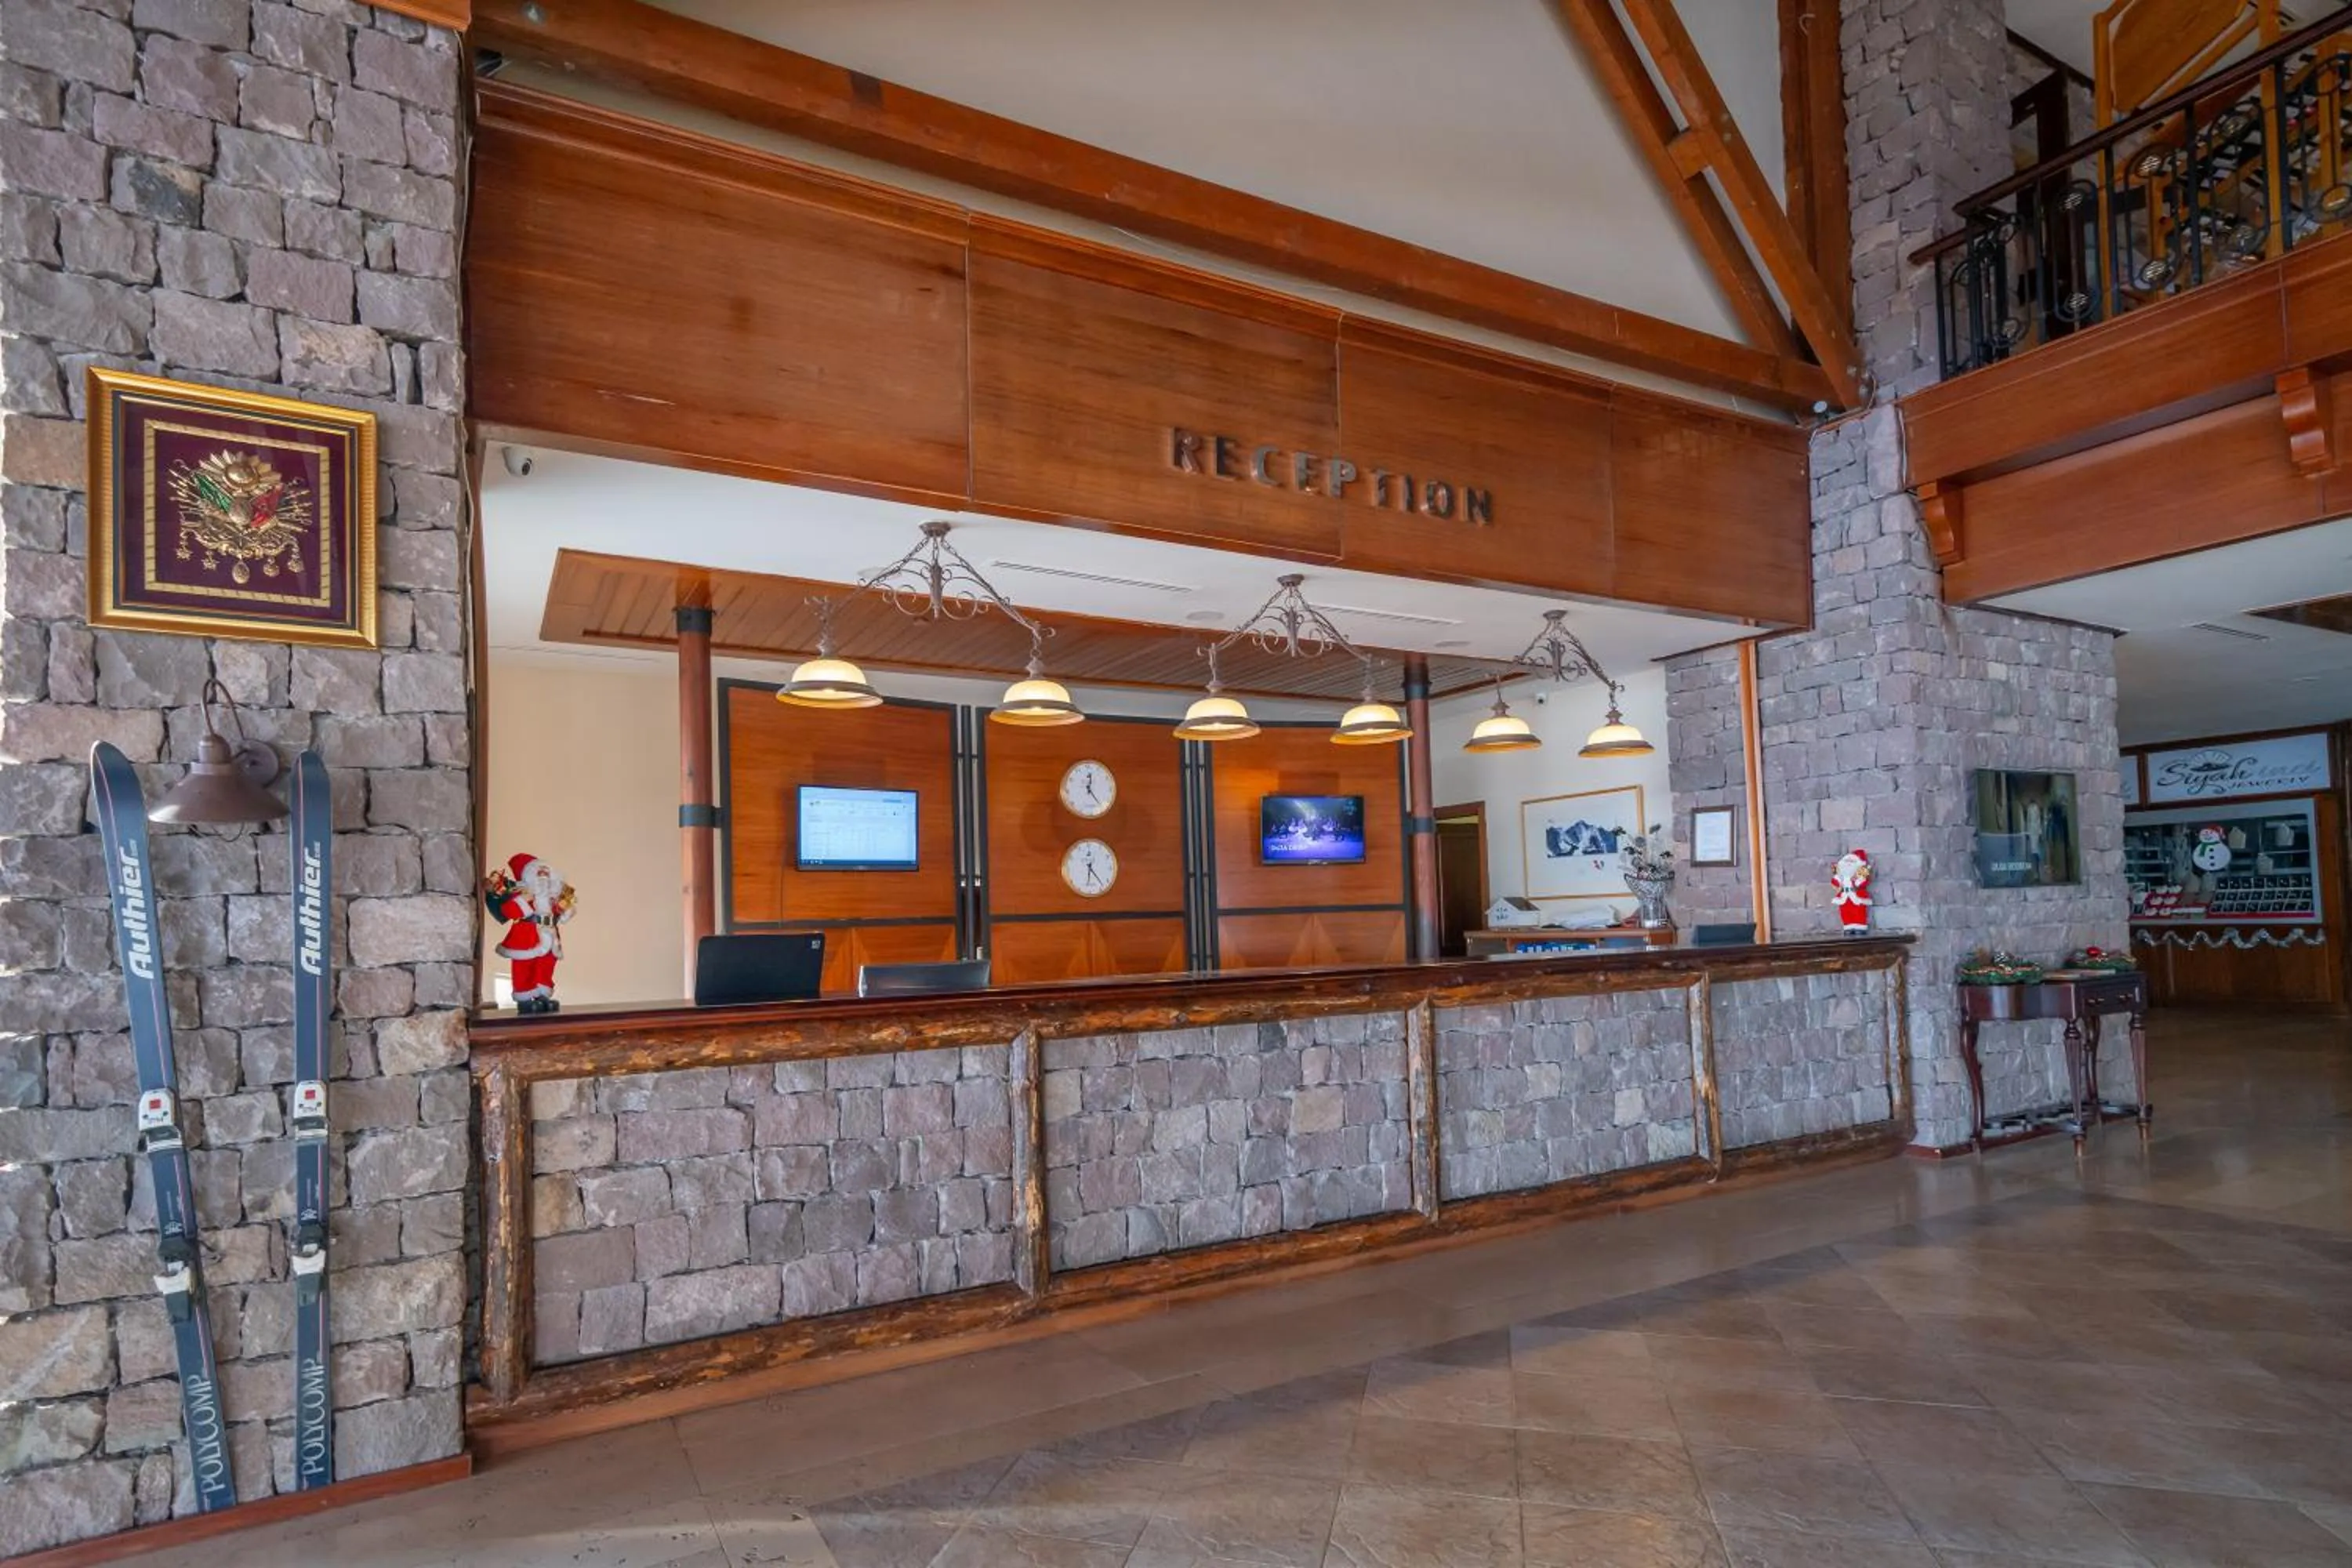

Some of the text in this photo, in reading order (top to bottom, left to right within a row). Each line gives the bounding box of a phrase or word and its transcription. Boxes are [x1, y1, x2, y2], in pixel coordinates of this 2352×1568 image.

[1171, 426, 1490, 525] RECEPTION
[118, 846, 154, 979] Authier
[299, 847, 322, 975] Authier
[187, 1374, 226, 1493] POLYCOMP
[301, 1358, 325, 1475] POLYCOMP
